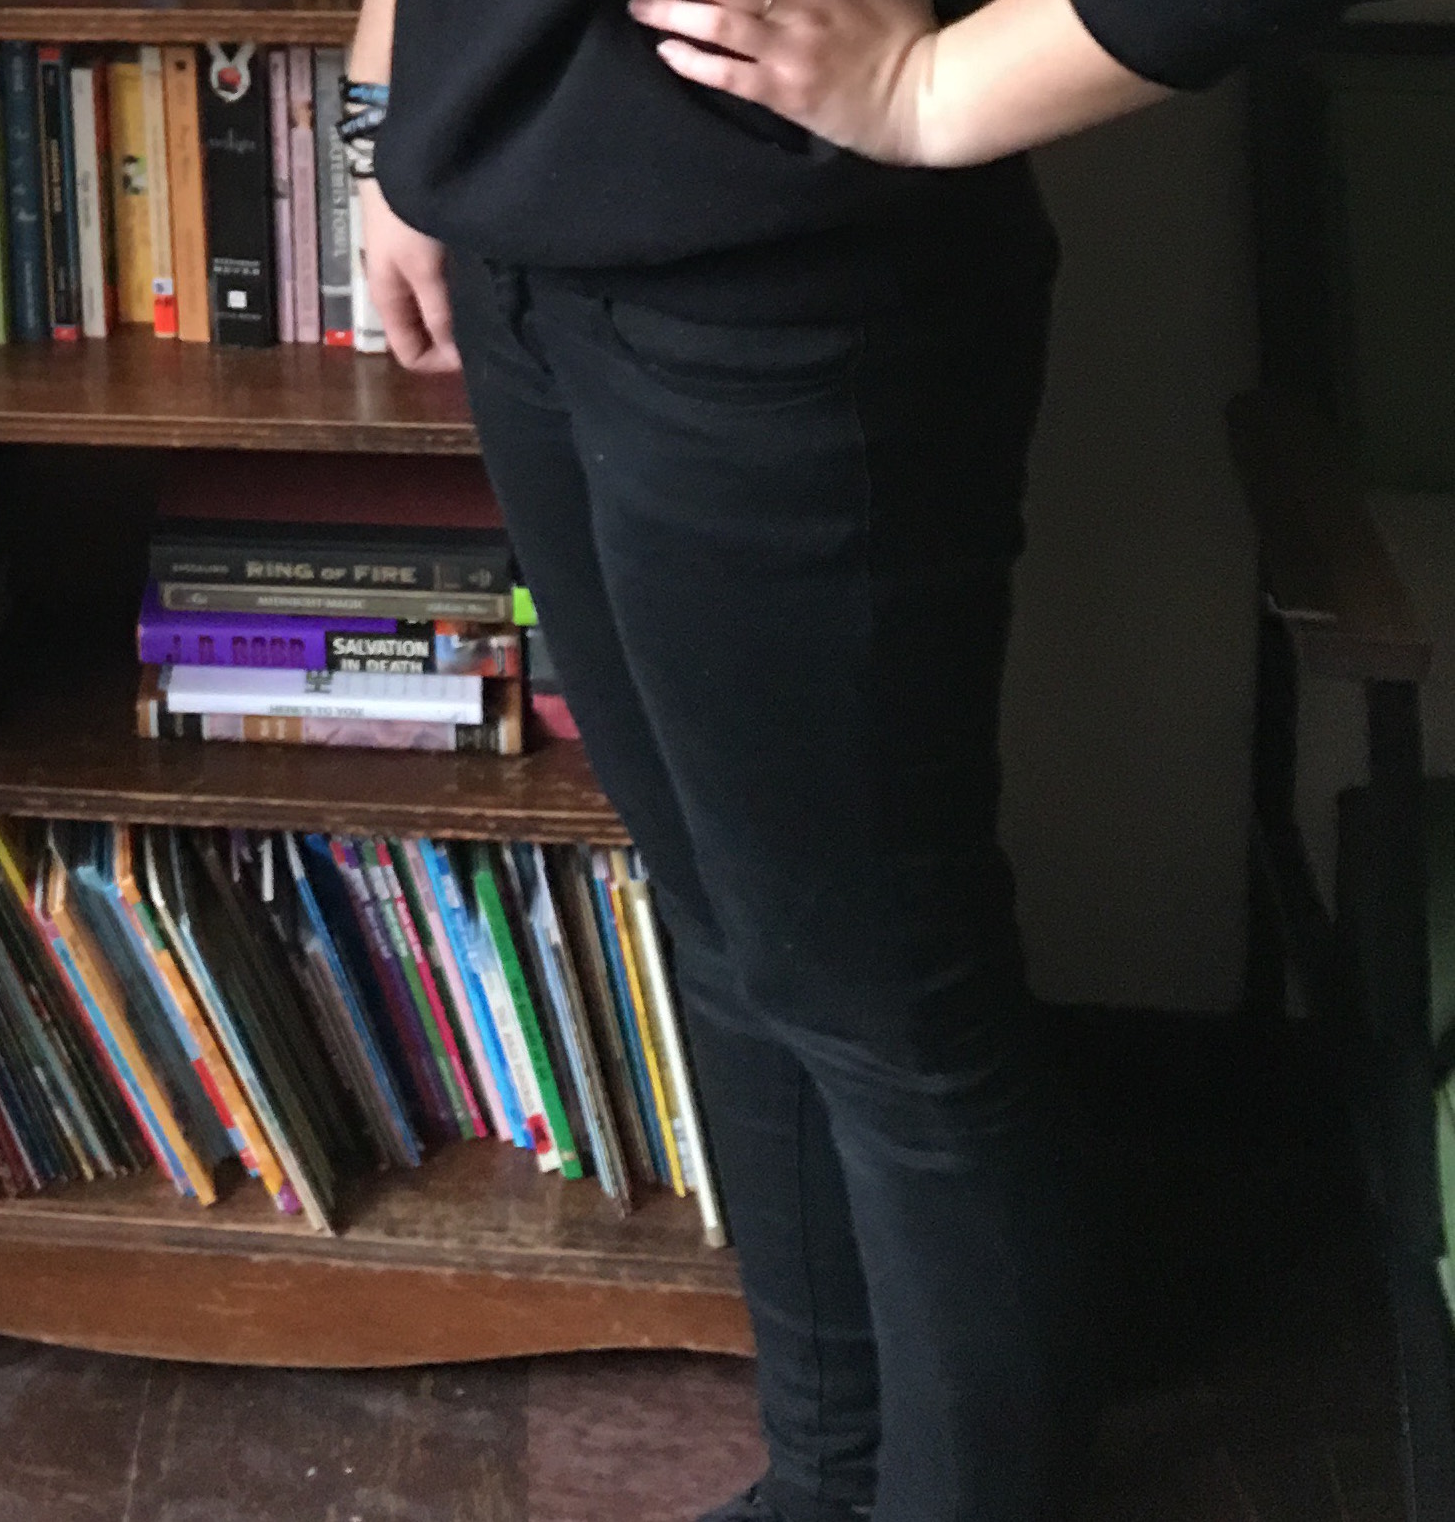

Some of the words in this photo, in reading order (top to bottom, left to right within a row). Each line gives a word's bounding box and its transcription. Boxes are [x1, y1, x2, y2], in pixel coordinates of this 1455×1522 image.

[247, 561, 314, 579] RING
[353, 565, 417, 584] FIRE
[332, 636, 430, 658] SALVATION
[341, 659, 361, 672] IN
[366, 660, 424, 674] DEATH
